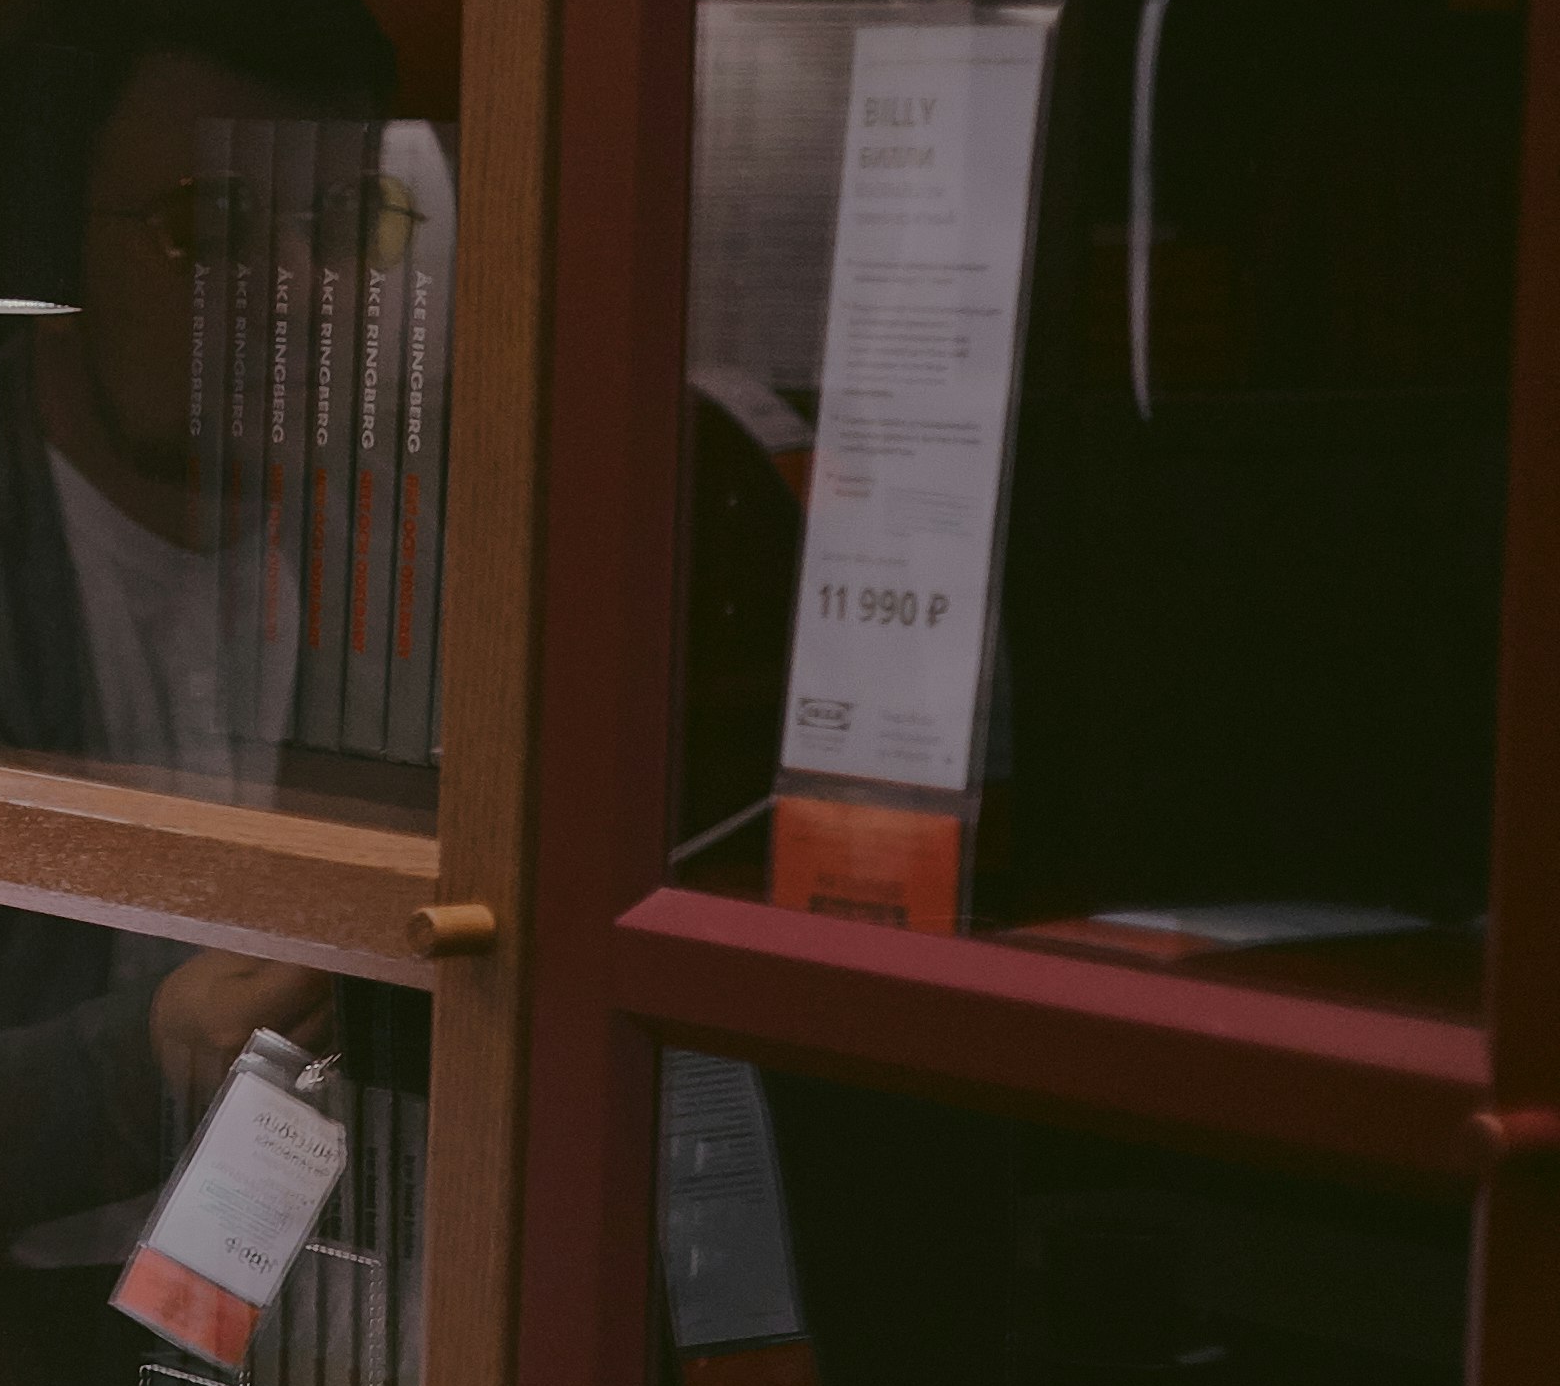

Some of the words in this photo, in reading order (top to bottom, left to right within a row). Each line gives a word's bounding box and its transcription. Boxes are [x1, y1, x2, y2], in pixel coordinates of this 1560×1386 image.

[276, 265, 295, 315] ÅKE
[320, 266, 339, 317] ÅKE
[366, 265, 385, 318] ÅKE
[413, 269, 433, 321] ÅKE
[271, 318, 290, 446] RINGBERG
[316, 320, 335, 448] RINGBERG
[361, 321, 381, 451] RINGBERG
[407, 323, 428, 455] RINGBERG
